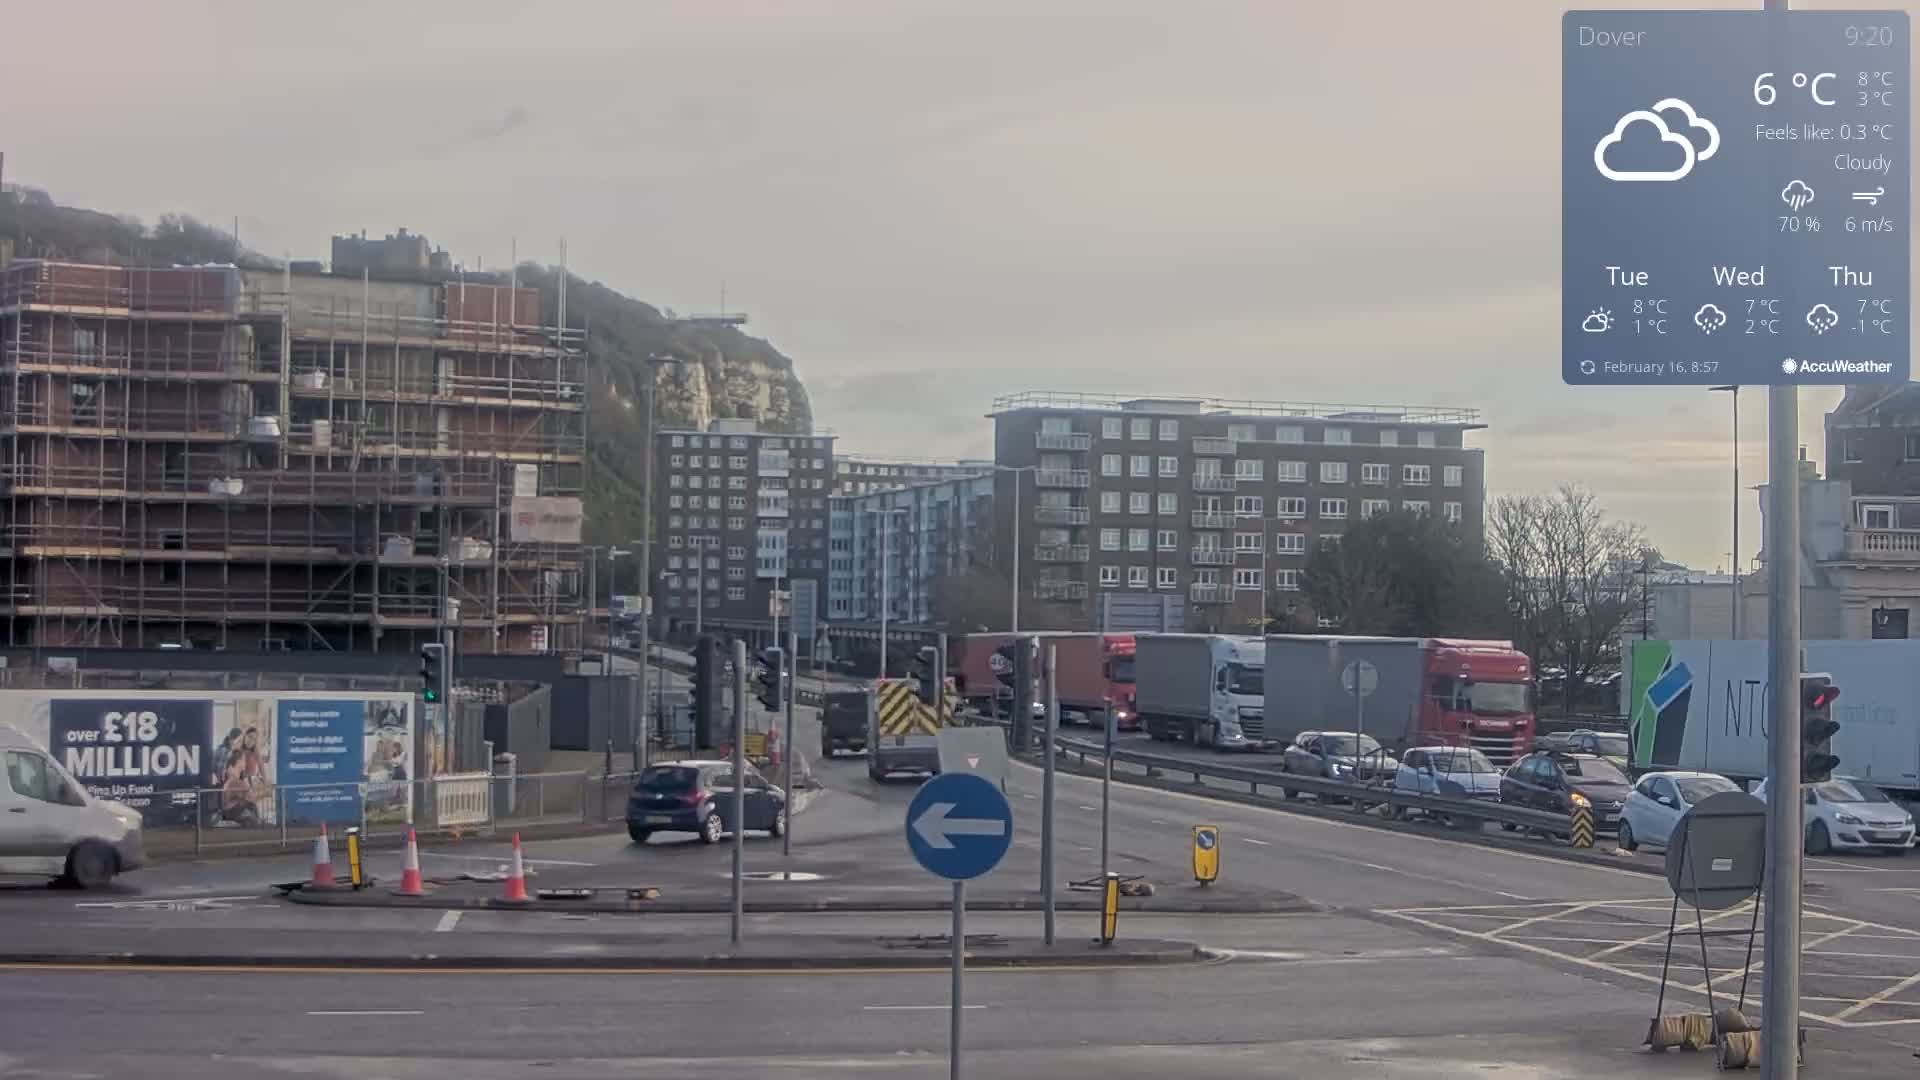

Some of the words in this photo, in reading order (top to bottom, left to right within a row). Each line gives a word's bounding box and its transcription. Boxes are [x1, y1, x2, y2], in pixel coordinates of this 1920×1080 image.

[66, 729, 100, 742] over
[104, 711, 158, 741] £18
[66, 745, 200, 776] MILLION
[128, 784, 154, 795] Fund
